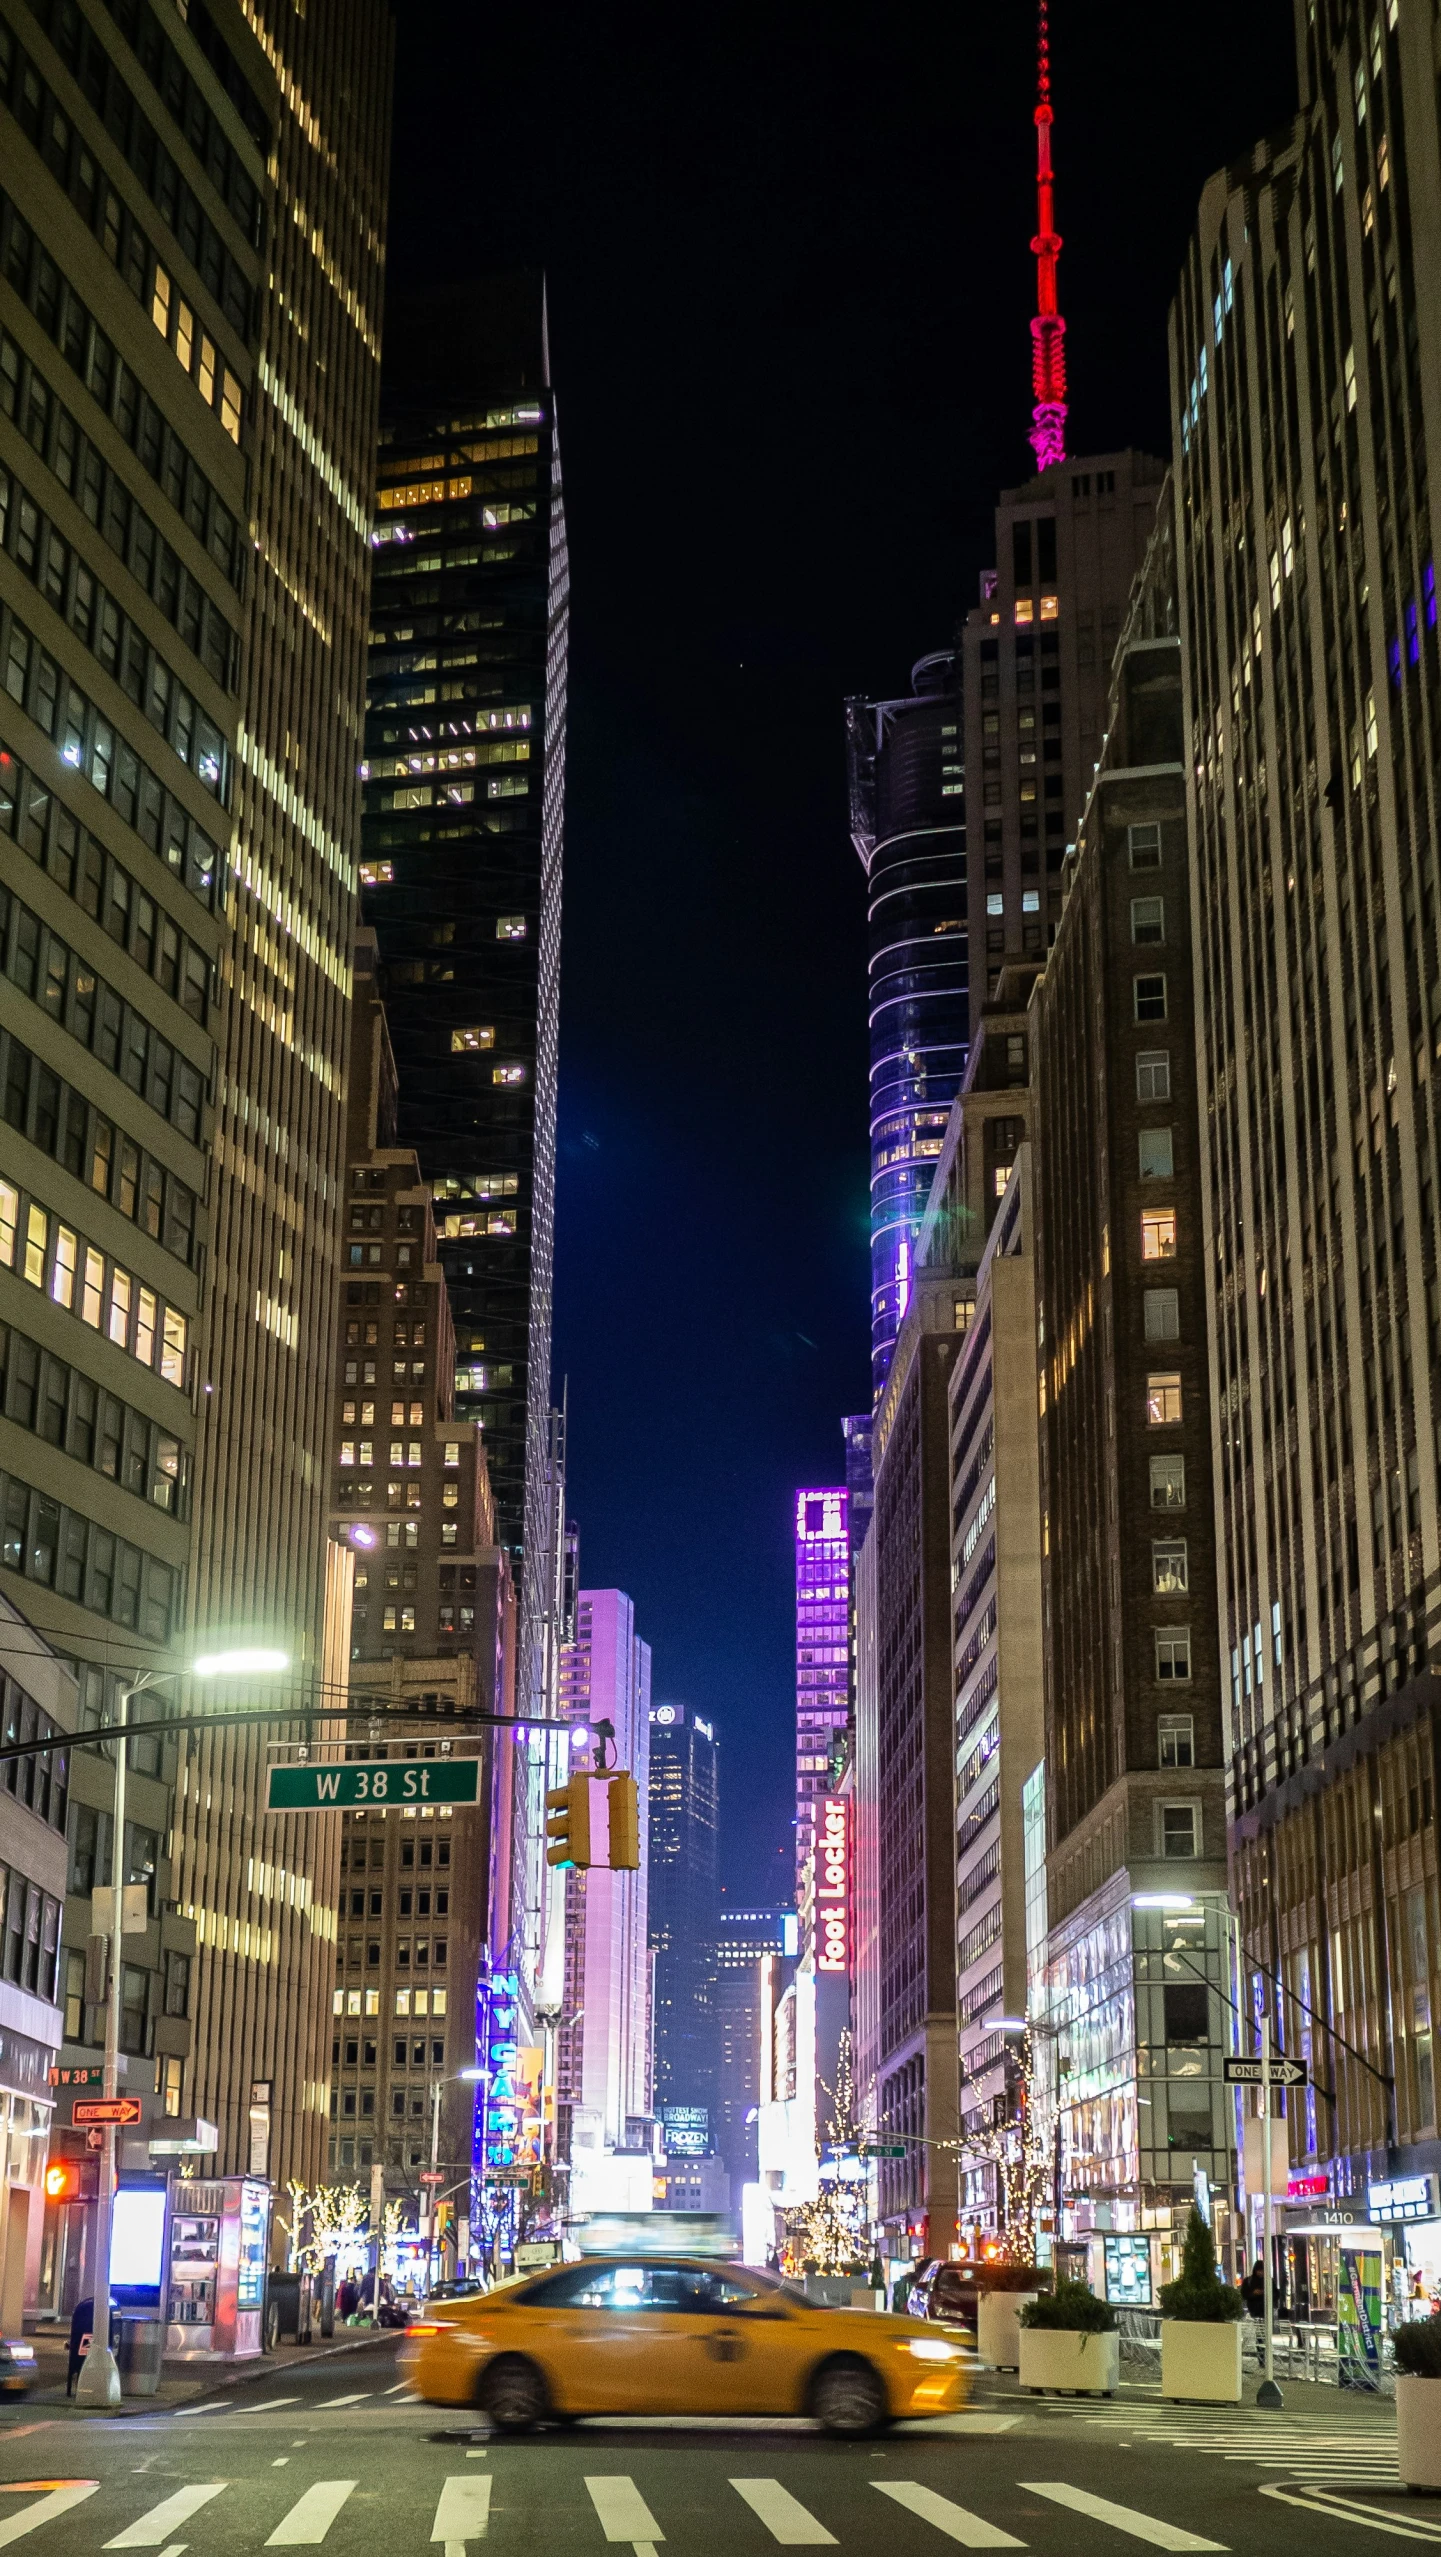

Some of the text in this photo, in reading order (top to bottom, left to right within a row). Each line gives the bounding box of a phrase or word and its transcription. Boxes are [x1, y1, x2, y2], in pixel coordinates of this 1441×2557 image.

[316, 1769, 430, 1800] W 38 St
[819, 1907, 846, 1971] Foot
[61, 2069, 100, 2084] W 38 ST
[1235, 2066, 1294, 2078] ONE WAY
[79, 2106, 132, 2117] ONE WAY
[665, 2129, 708, 2145] FROZEN
[1324, 2211, 1354, 2225] 1410
